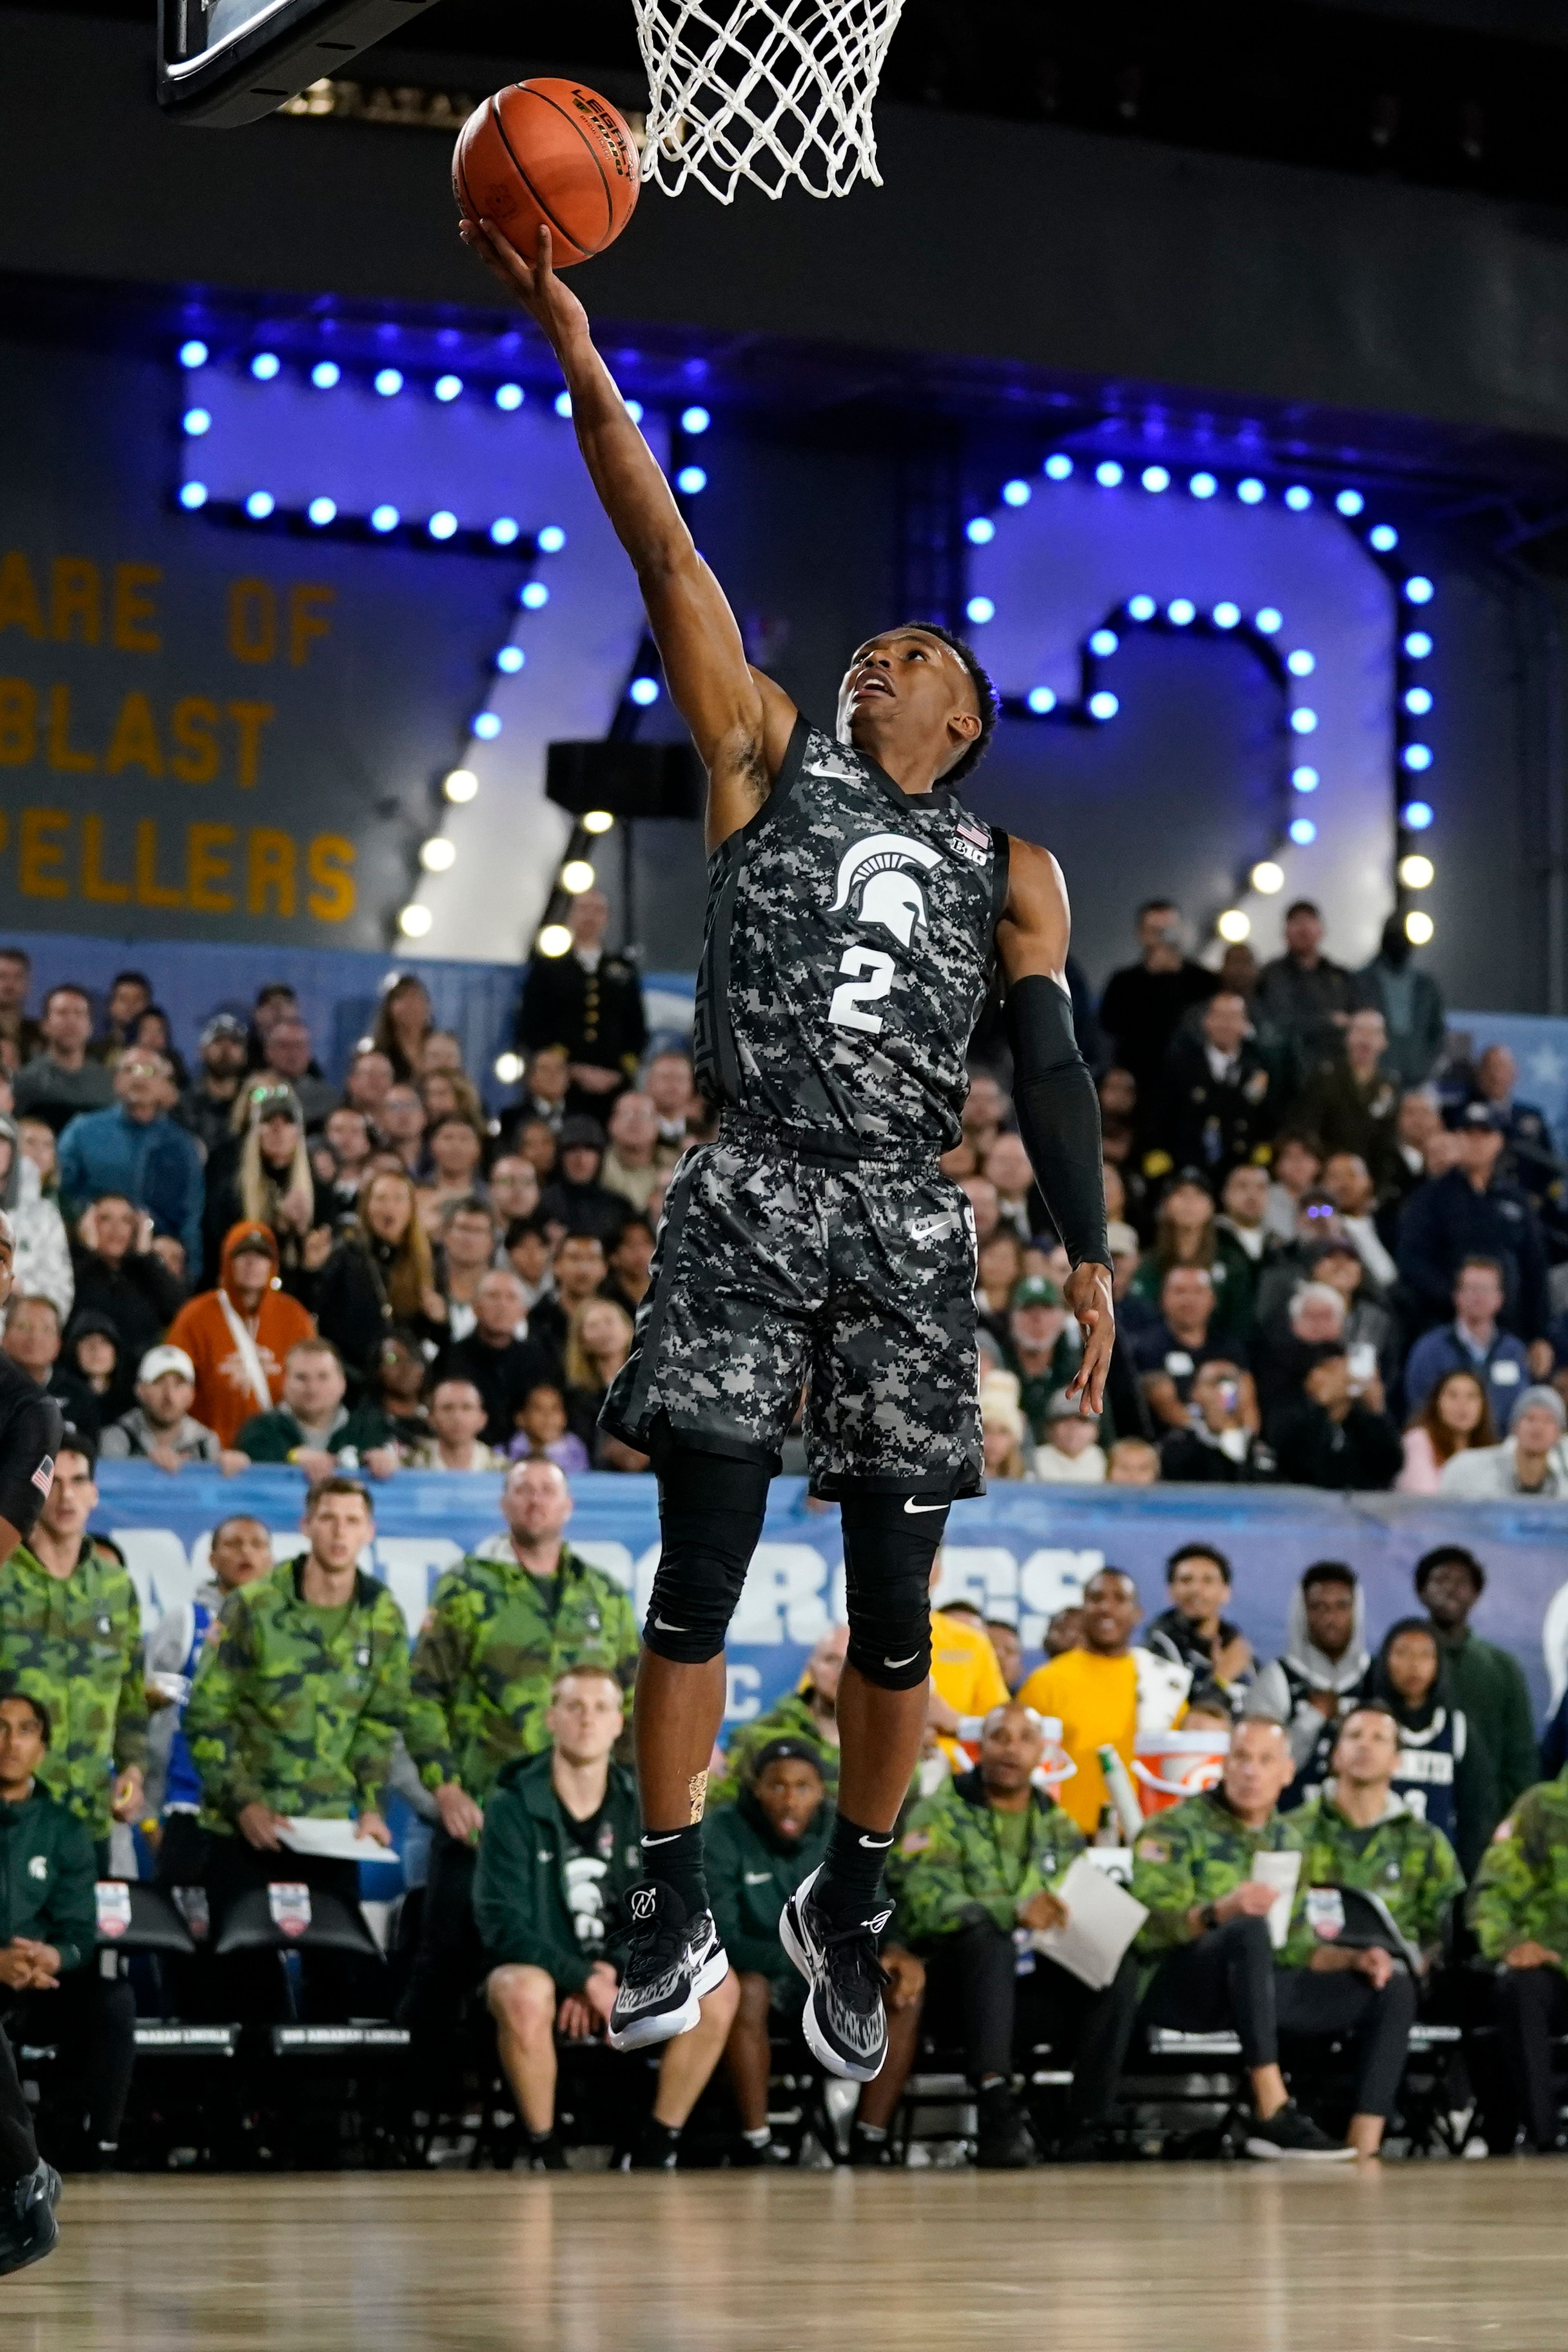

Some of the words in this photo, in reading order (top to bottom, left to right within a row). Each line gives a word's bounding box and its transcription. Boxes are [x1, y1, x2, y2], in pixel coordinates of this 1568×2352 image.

[226, 577, 337, 669] OF
[0, 677, 276, 788] BLAST
[0, 807, 356, 922] ELLERS
[828, 945, 896, 1034] 2
